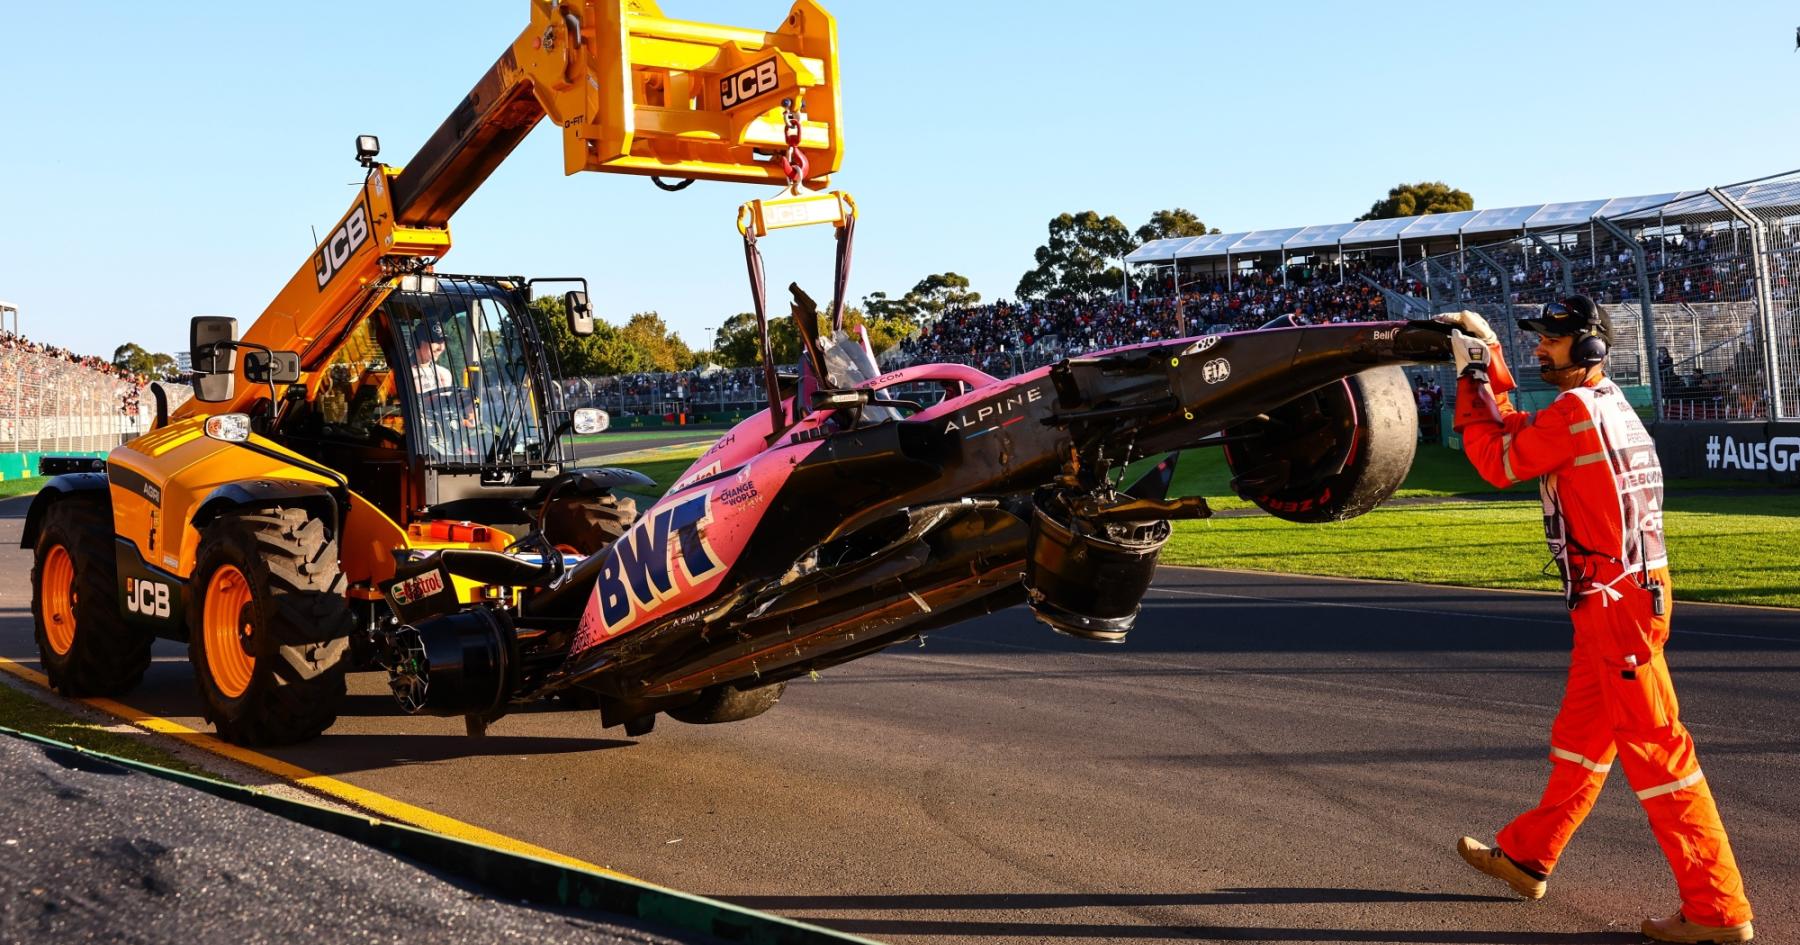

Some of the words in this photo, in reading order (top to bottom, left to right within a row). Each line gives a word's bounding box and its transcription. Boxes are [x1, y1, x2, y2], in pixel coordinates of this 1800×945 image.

[722, 61, 777, 107] JCB
[317, 207, 367, 287] JCB
[1373, 330, 1390, 340] Bell
[1203, 362, 1229, 381] FIA
[943, 386, 1042, 435] ALPINE
[143, 482, 160, 503] AGRI
[720, 480, 755, 502] CHANGE
[728, 489, 758, 506] WORLD
[598, 493, 716, 629] BWT
[127, 578, 171, 618] JCB
